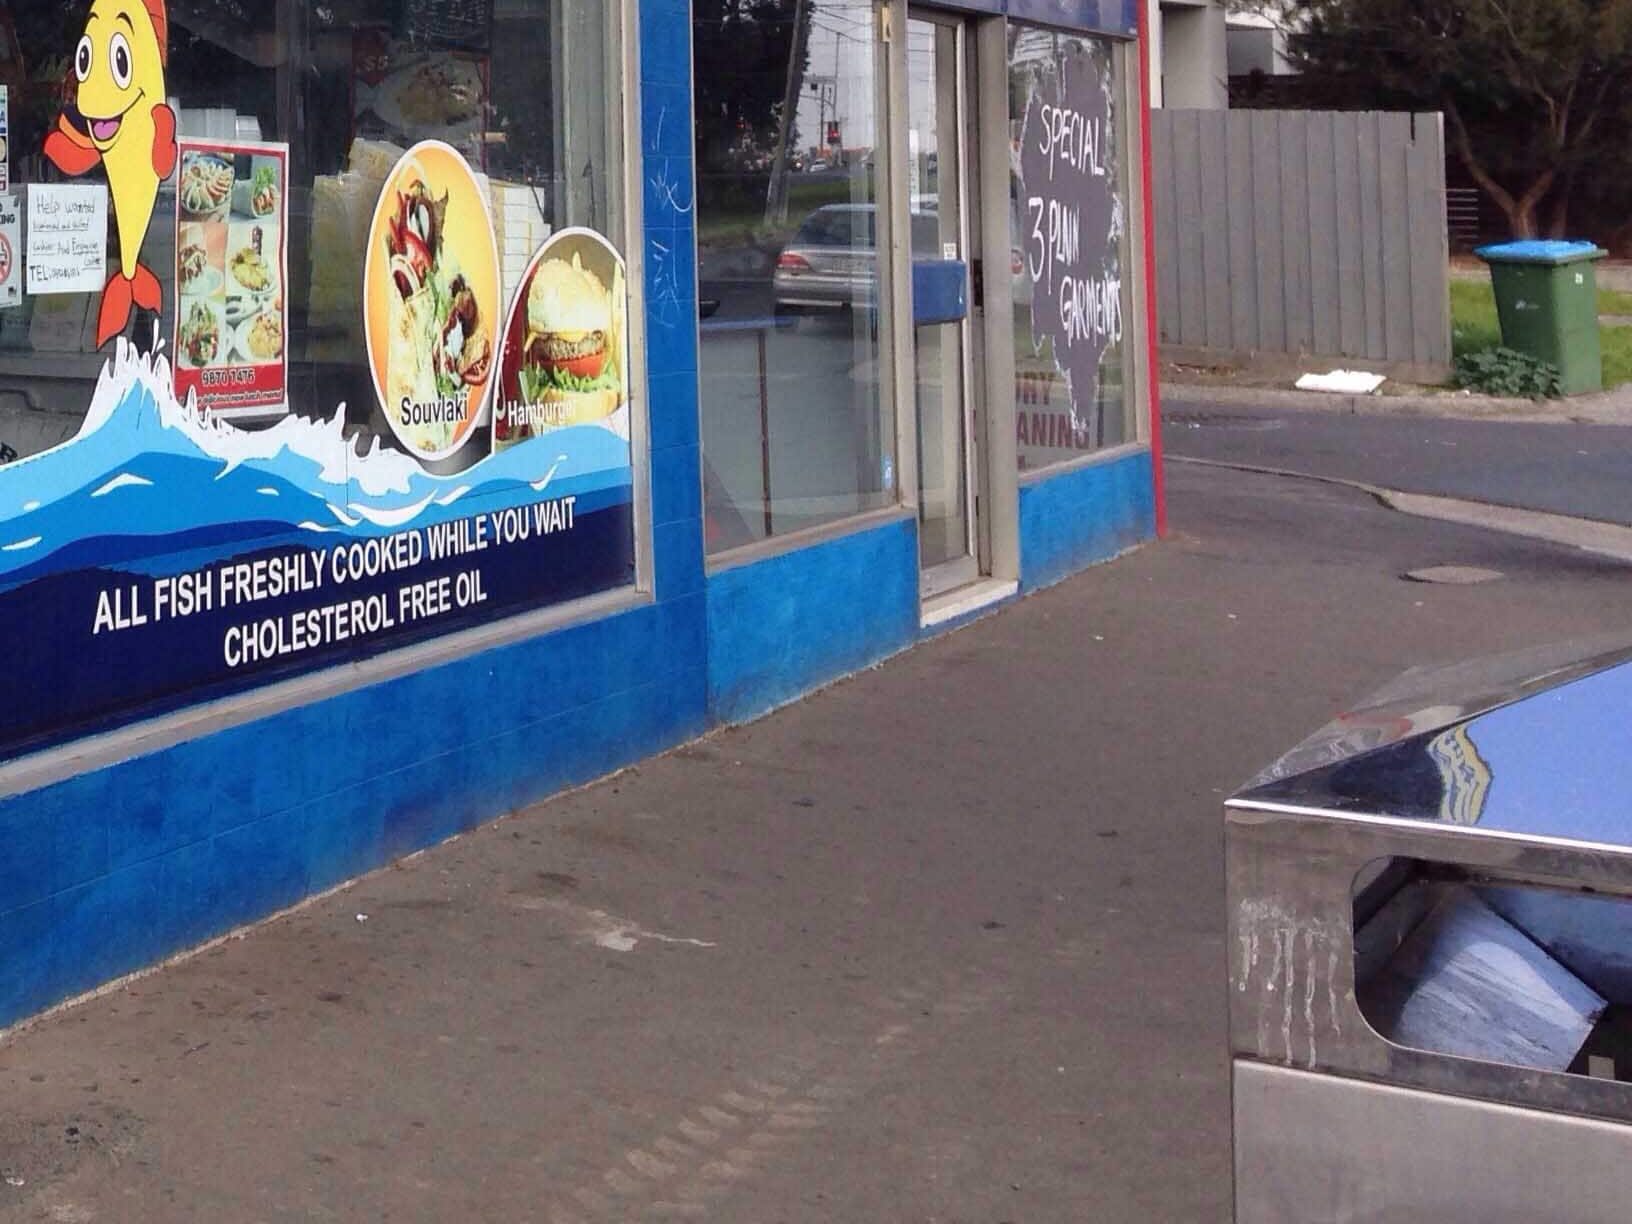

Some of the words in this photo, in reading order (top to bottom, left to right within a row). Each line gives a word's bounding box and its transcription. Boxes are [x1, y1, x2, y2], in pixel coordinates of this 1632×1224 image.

[1039, 104, 1105, 181] SPECIAL
[1028, 196, 1045, 283] 3
[1060, 275, 1122, 348] GARMENTS
[201, 369, 227, 386] 9870
[401, 392, 468, 426] Souvlaki
[507, 398, 576, 426] Hamburger
[92, 586, 147, 634] ALL
[154, 569, 213, 621] FISH
[219, 548, 327, 606] FRESHLY
[332, 531, 422, 583] COOKED
[426, 519, 488, 559] WHILE
[491, 507, 530, 545] YOU
[533, 496, 577, 537] WAIT
[224, 595, 394, 667] CHOLESTEROL
[399, 576, 452, 623] FREE
[455, 569, 487, 607] OIL
